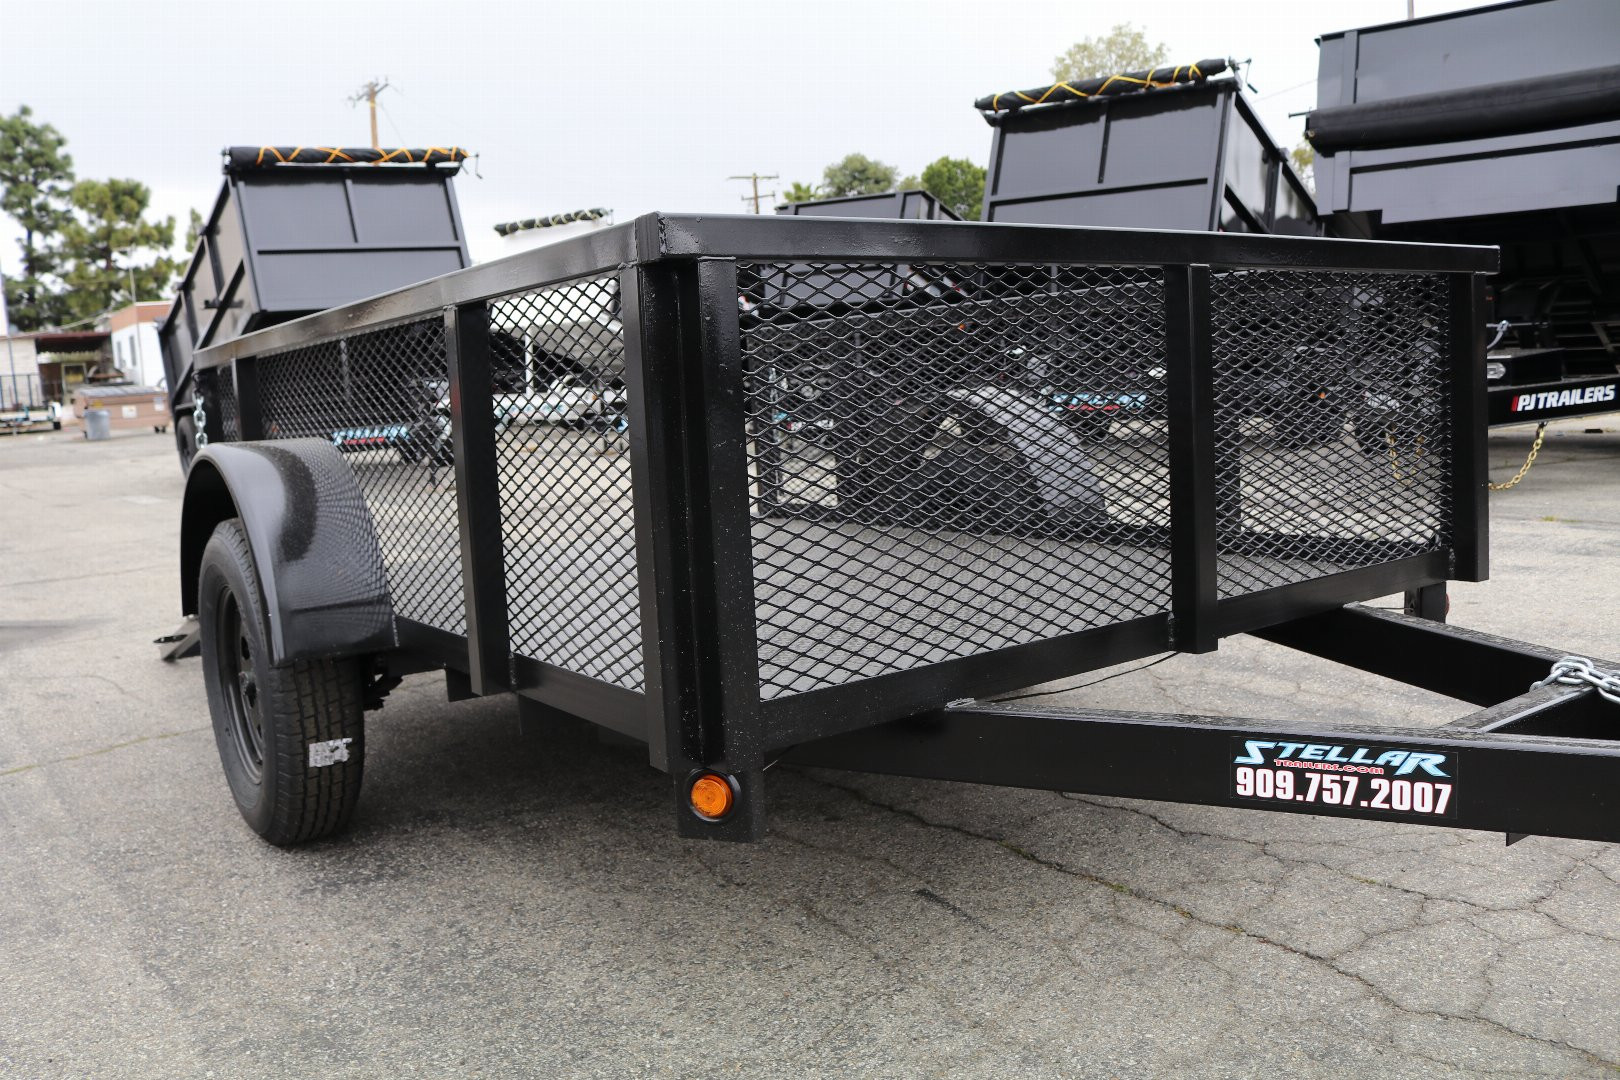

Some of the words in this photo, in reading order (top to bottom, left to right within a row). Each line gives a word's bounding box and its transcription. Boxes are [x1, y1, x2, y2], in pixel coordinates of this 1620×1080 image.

[1537, 385, 1616, 408] TRAILERS
[1233, 740, 1451, 777] STELLAR
[1236, 767, 1452, 815] 909.757.2007
